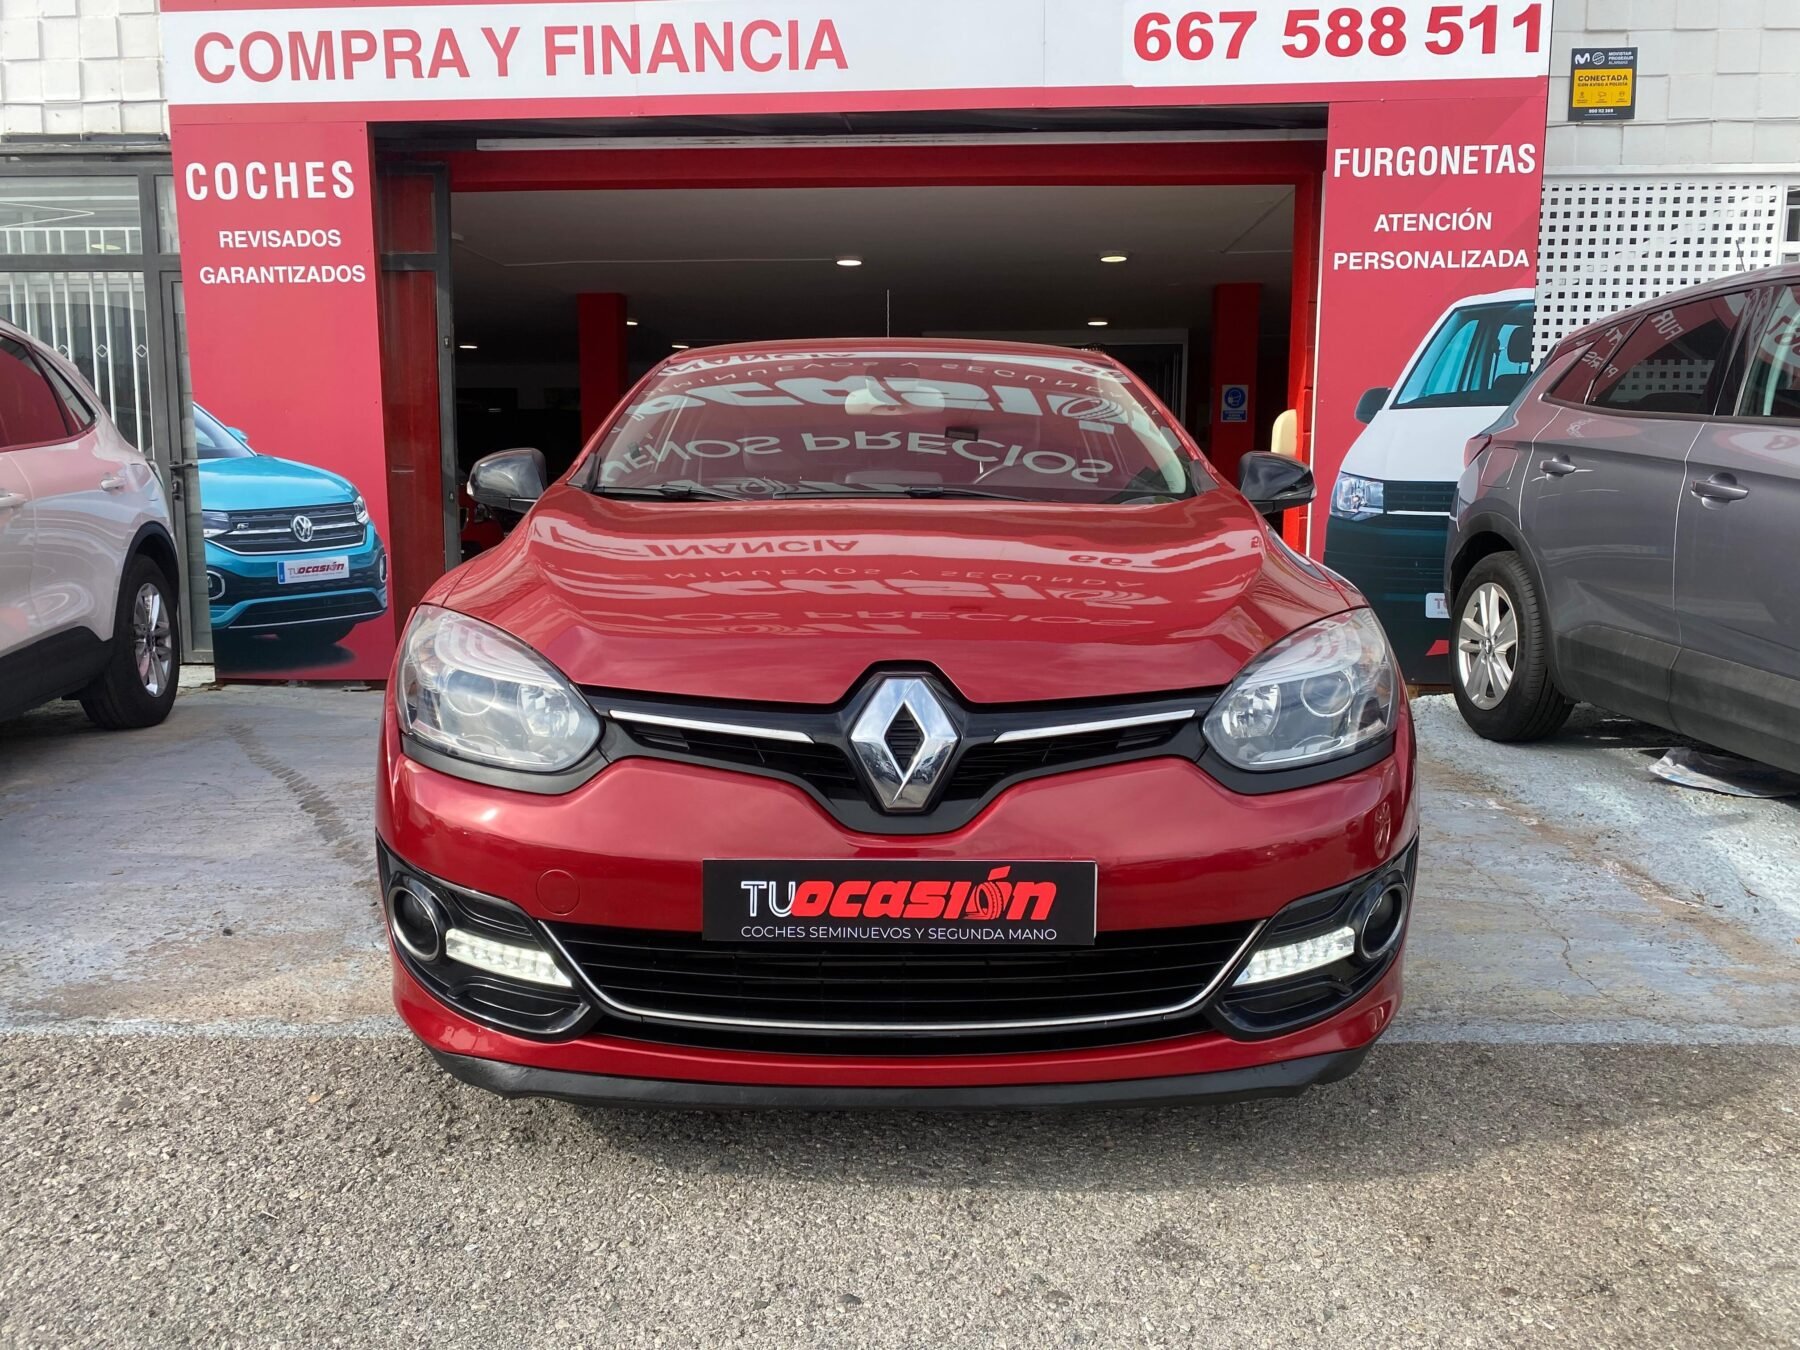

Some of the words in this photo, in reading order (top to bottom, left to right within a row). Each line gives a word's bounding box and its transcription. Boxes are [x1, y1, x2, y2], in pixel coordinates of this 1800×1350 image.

[1133, 11, 1257, 62] 667
[1281, 6, 1407, 58] 588
[1424, 3, 1542, 55] 511
[194, 28, 470, 83] COMPRA
[480, 27, 521, 77] Y
[544, 19, 848, 76] FINANCIA
[1333, 143, 1536, 178] FURGONETAS
[185, 160, 355, 201] COCHES
[1374, 207, 1492, 233] ATENCIÓN
[218, 229, 342, 249] REVISADOS
[1333, 249, 1530, 271] PERSONALIZADA
[199, 264, 366, 285] GARANTIZADOS
[740, 926, 806, 938] COCHES
[809, 926, 912, 939] SEMINUEVOS
[913, 927, 925, 939] Y
[928, 928, 1005, 940] SEGUNDA
[1008, 928, 1057, 941] MANO
